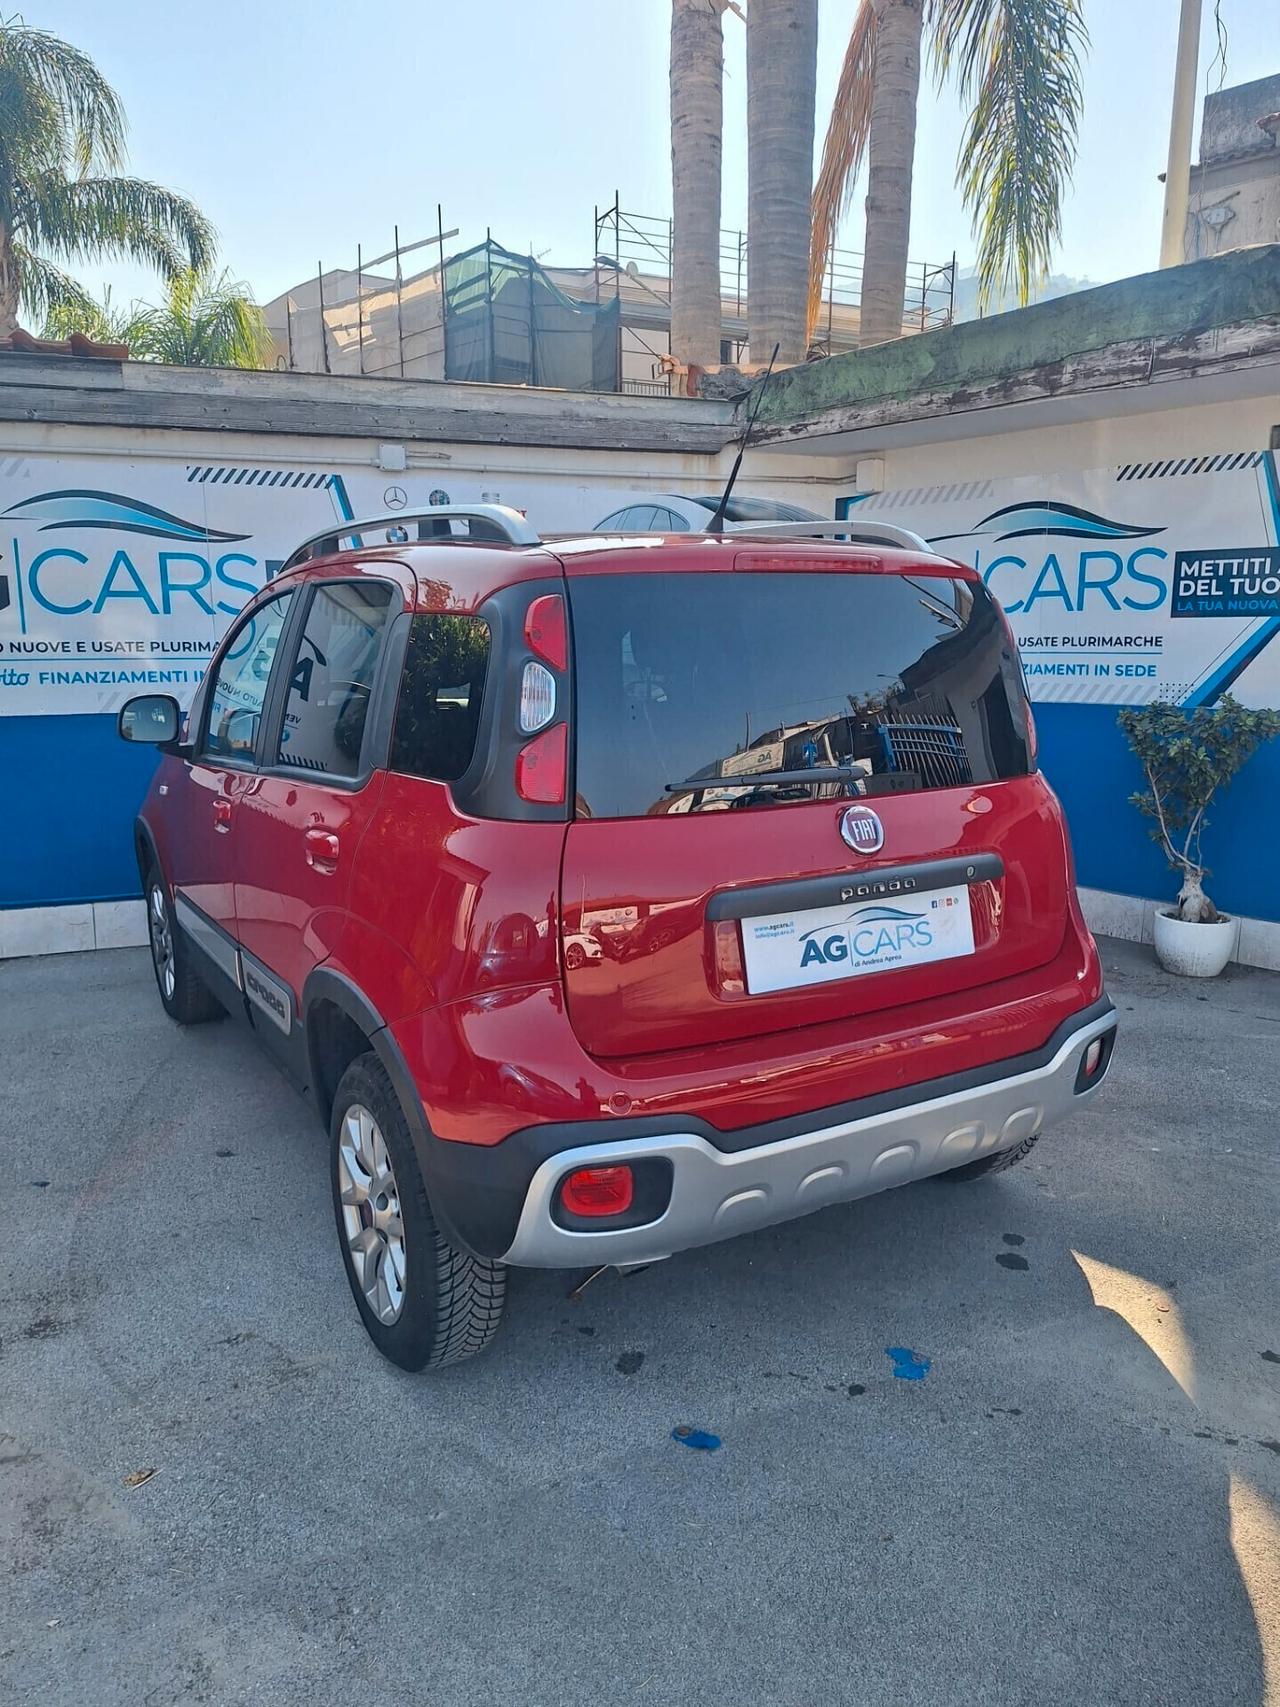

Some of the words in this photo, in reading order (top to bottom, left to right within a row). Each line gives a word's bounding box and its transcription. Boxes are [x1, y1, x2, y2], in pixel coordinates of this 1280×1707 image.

[1180, 557, 1272, 578] METTITI
[28, 548, 260, 616] CARS
[985, 547, 1169, 614] CARS
[1178, 579, 1224, 597] DEL
[1229, 577, 1280, 595] TUO
[1177, 601, 1194, 611] LA
[1197, 601, 1224, 611] TUA
[1228, 599, 1279, 610] NUOVA
[10, 641, 71, 653] NUOVE
[77, 641, 87, 653] E
[92, 641, 145, 653] USATE
[1018, 636, 1059, 648] USATE
[1061, 636, 1164, 648] PLURIMARCHE
[39, 670, 188, 685] FINANZIAMENTI
[1095, 664, 1110, 677] IN
[1114, 664, 1158, 677] SEDE
[851, 818, 877, 842] FIAT
[841, 877, 917, 902] panda
[800, 934, 849, 968] AG
[853, 921, 933, 957] CARS
[854, 960, 862, 968] di
